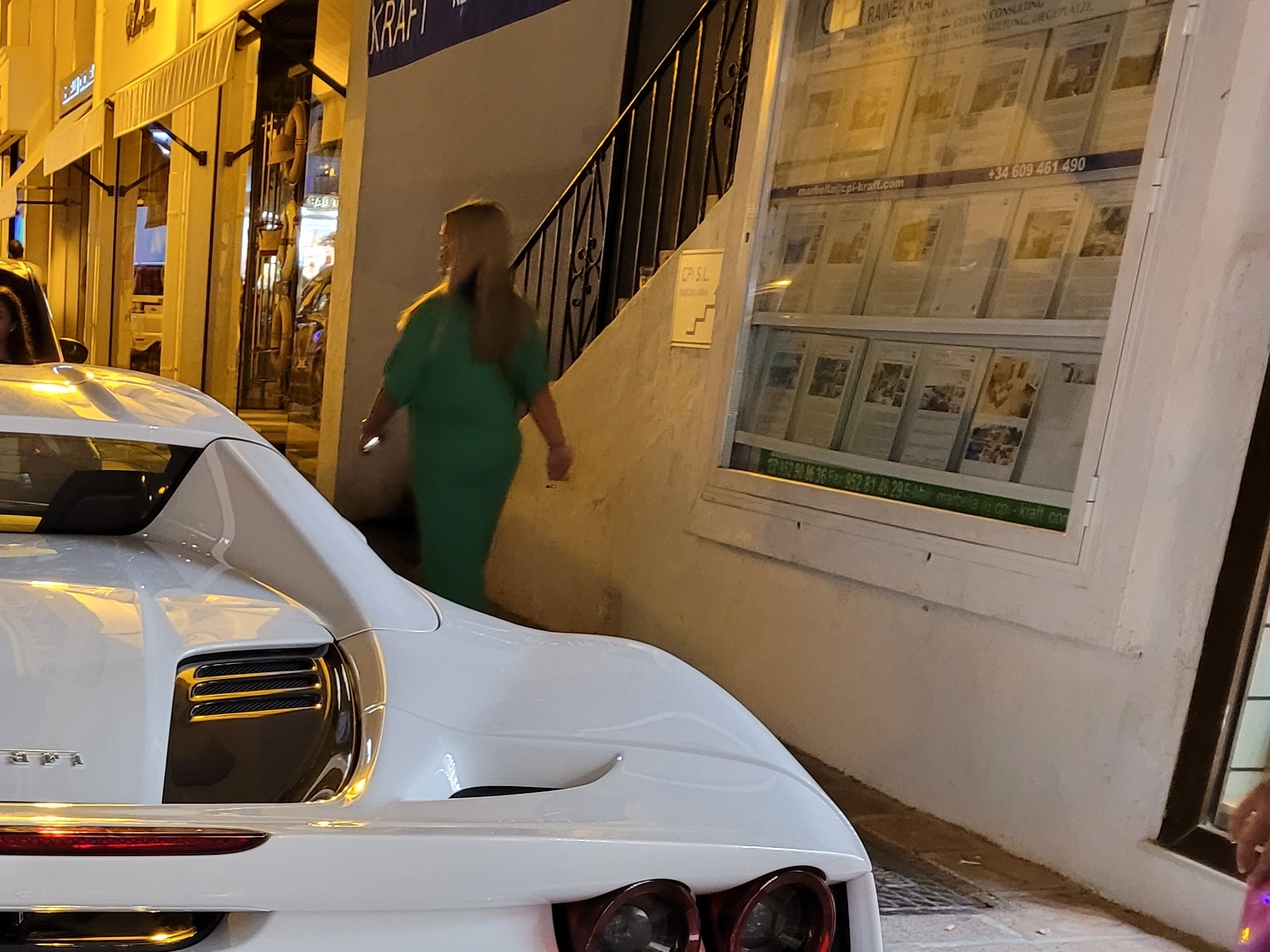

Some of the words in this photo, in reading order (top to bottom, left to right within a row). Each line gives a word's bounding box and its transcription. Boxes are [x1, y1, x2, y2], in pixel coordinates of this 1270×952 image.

[989, 166, 1009, 180] +34
[1012, 163, 1033, 178] 609
[1036, 160, 1058, 175] 461
[1062, 157, 1086, 173] 490
[891, 479, 904, 498] 29
